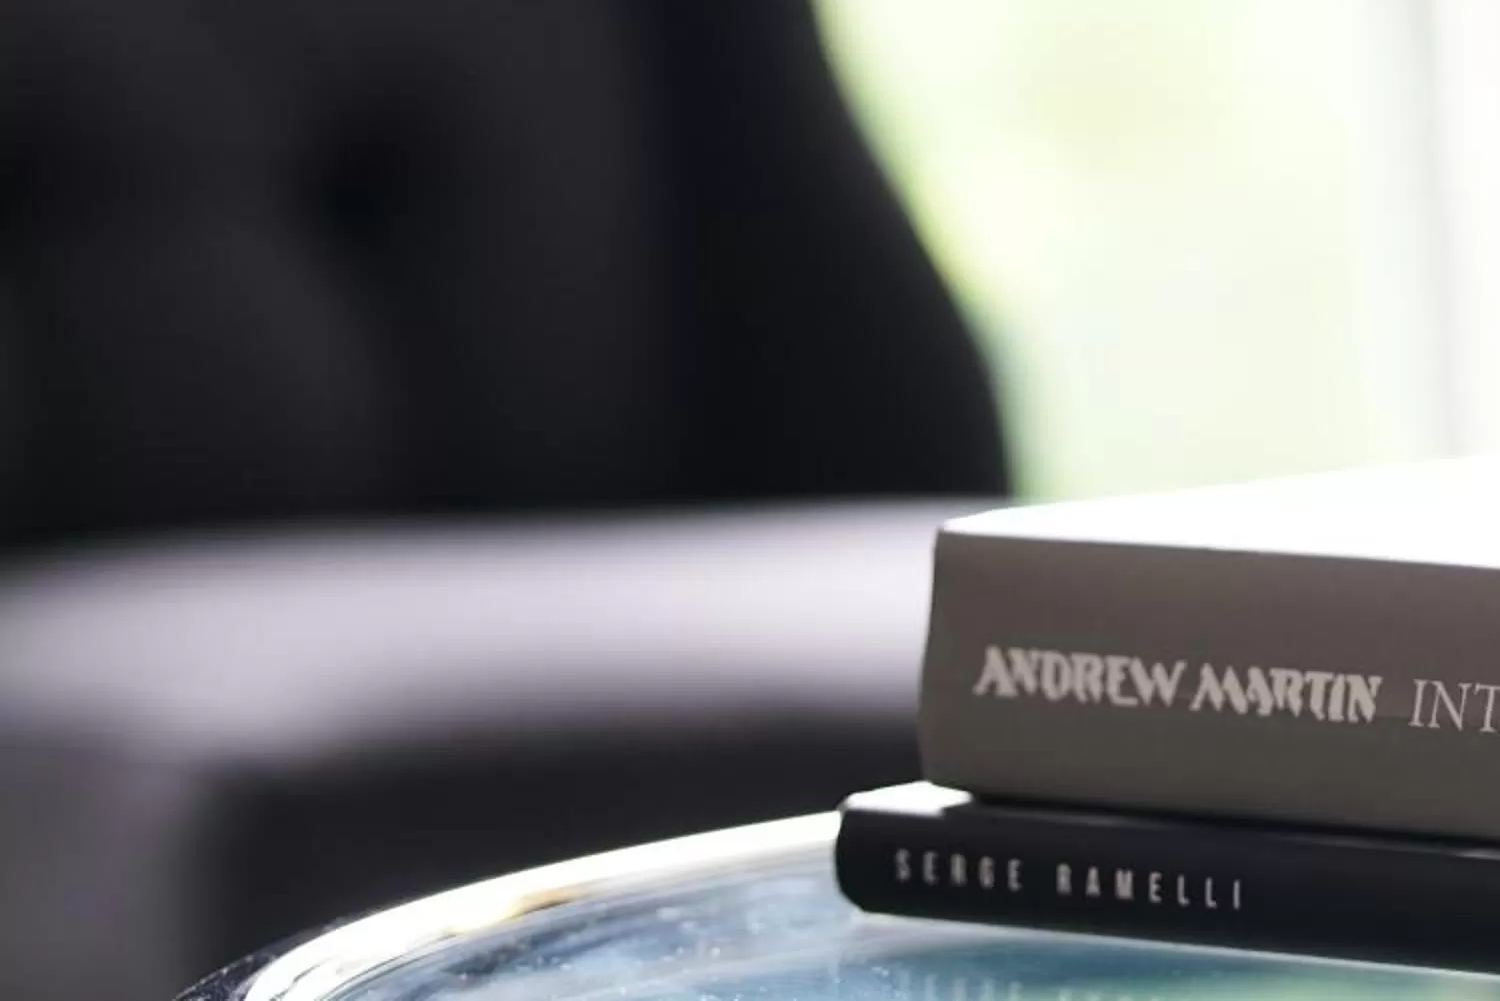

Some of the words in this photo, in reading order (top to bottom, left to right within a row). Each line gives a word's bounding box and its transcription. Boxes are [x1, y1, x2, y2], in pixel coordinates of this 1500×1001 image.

[974, 645, 1187, 707] ANDREW
[1191, 663, 1383, 724] MARTIN
[894, 847, 1023, 892] SERGE
[1055, 862, 1241, 911] RAMELLI
